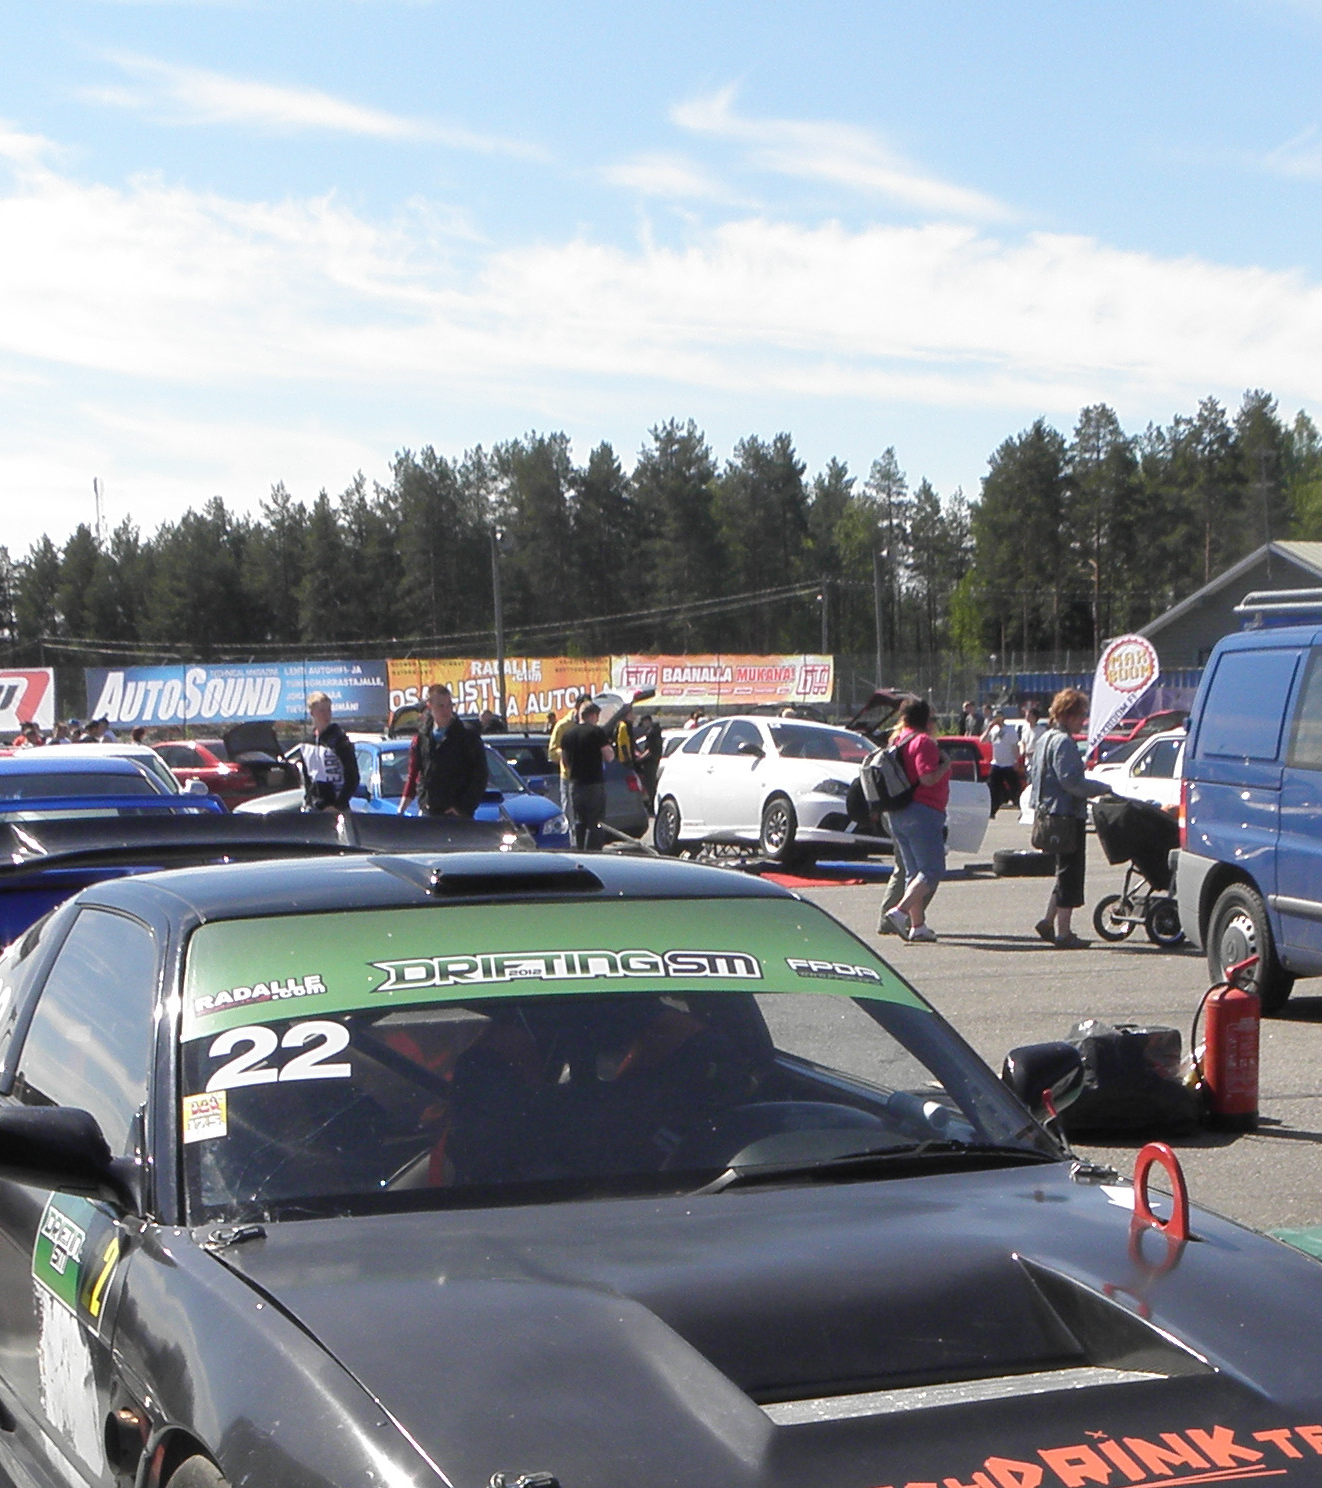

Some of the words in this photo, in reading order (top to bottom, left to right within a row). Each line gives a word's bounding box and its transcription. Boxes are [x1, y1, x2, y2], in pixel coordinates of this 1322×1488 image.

[661, 666, 733, 684] BAANALLA
[785, 957, 882, 981] FPDA
[194, 974, 324, 1012] RADALLE
[205, 1020, 352, 1093] 22
